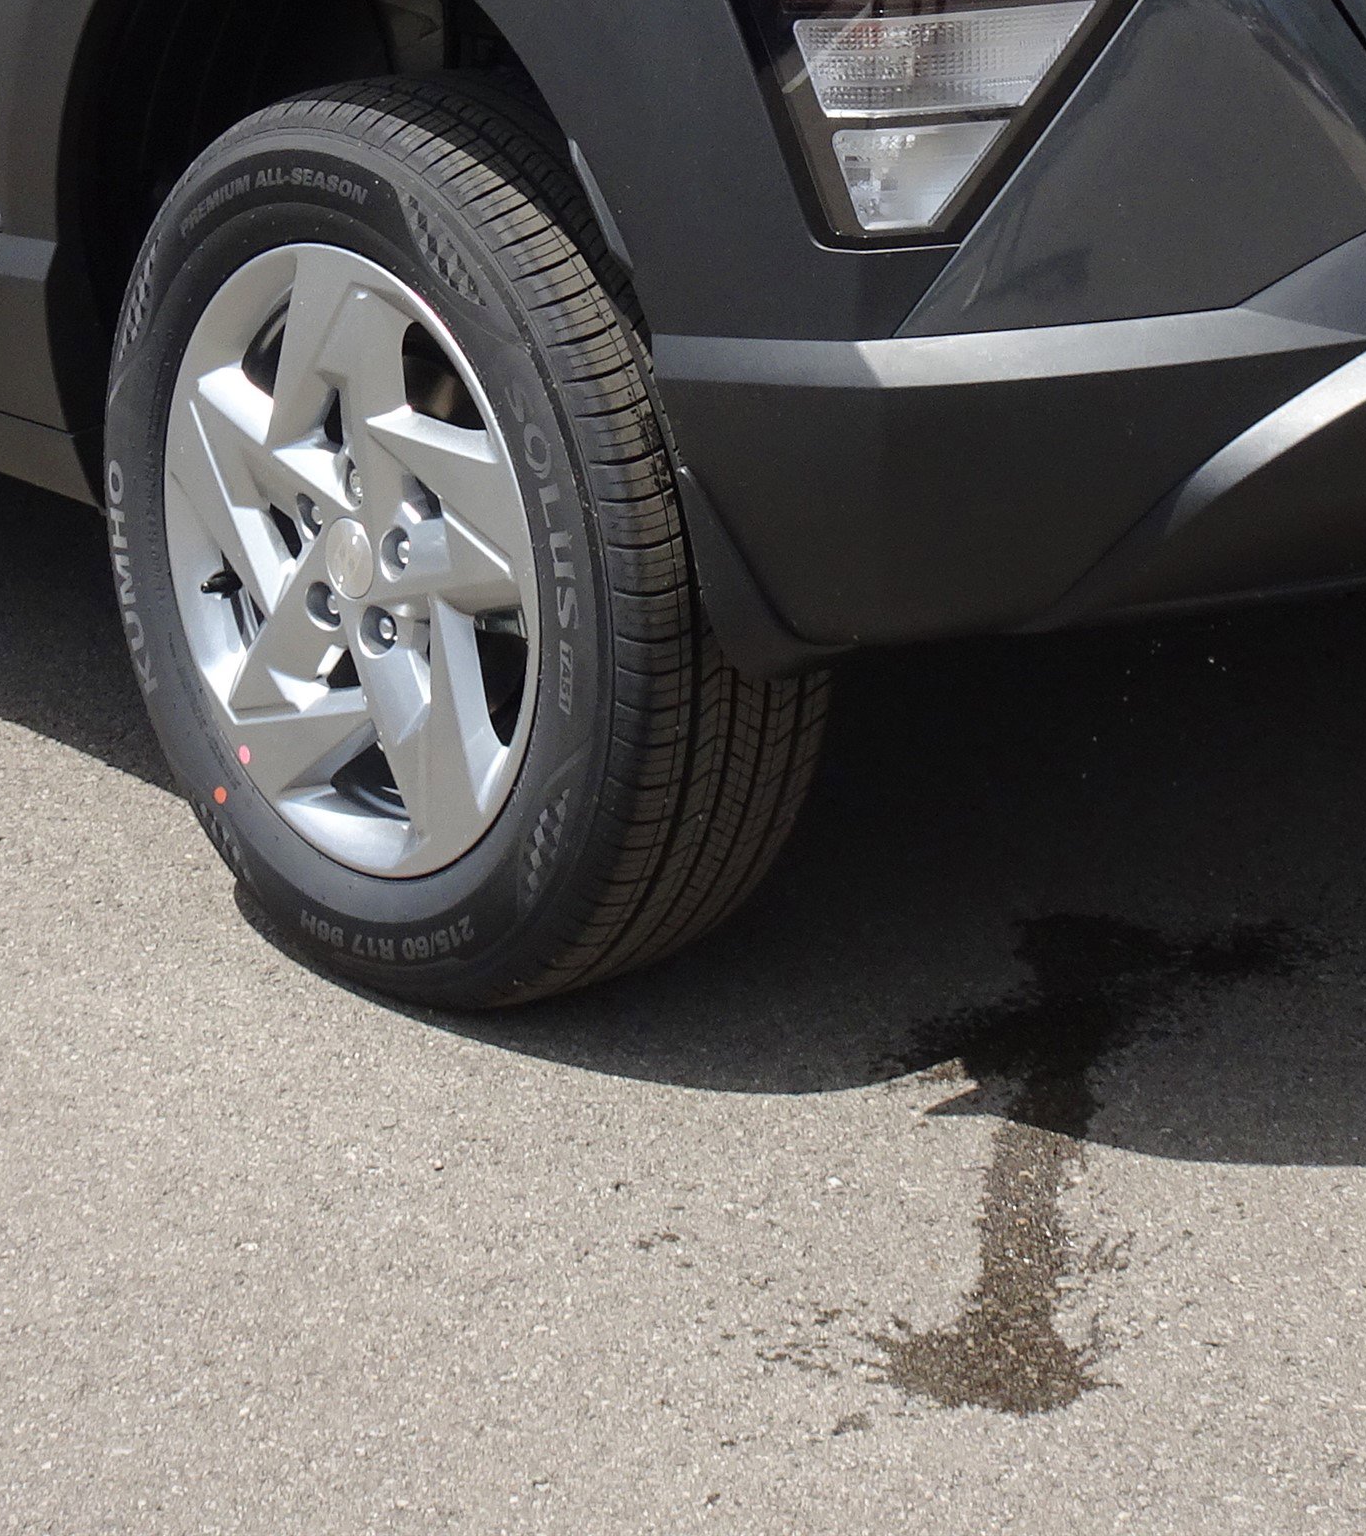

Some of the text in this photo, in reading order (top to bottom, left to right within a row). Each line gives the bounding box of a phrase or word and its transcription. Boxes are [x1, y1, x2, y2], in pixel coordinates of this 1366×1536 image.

[254, 166, 369, 205] ALL-SEASON
[504, 385, 580, 630] SOLUS
[108, 460, 159, 695] KUMHO
[352, 933, 396, 961] R17
